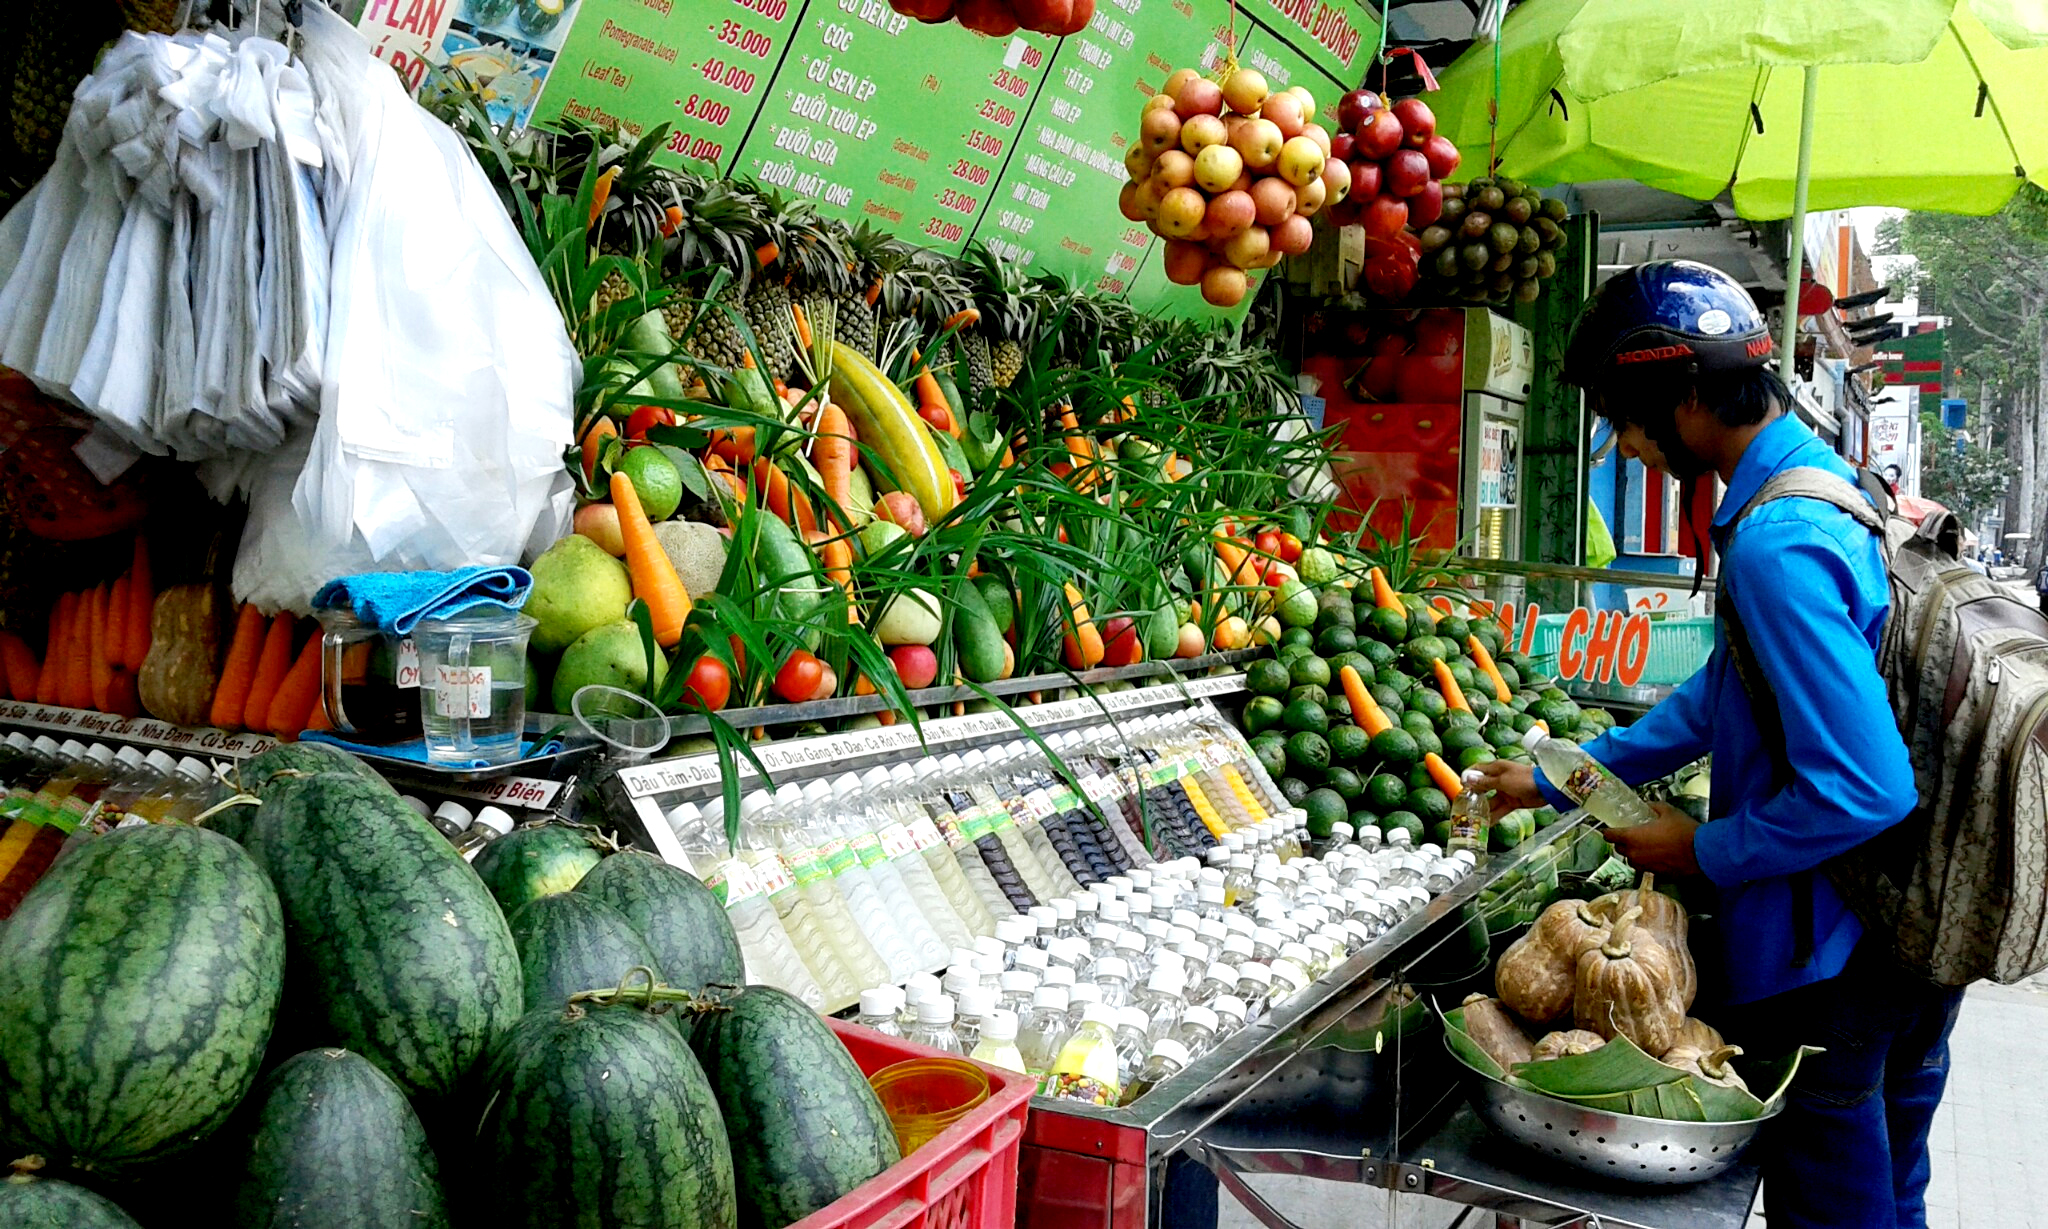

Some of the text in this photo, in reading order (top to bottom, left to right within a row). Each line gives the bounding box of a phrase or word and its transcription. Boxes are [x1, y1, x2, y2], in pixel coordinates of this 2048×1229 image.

[717, 18, 772, 59] 35.000
[701, 57, 756, 94] 40.000
[827, 66, 858, 96] SEN
[855, 75, 877, 102] ÉP
[993, 68, 1029, 99] 28.000
[562, 97, 591, 122] (Fresh
[684, 93, 731, 127] 8.000
[979, 98, 1016, 128] 25.000
[855, 115, 877, 141] ÉP
[965, 128, 1003, 158] 15.000
[952, 158, 990, 186] 28.000
[823, 183, 853, 208] ONG
[939, 188, 977, 215] 33.000
[925, 217, 963, 243] 33.000
[1616, 343, 1695, 365] HONDA
